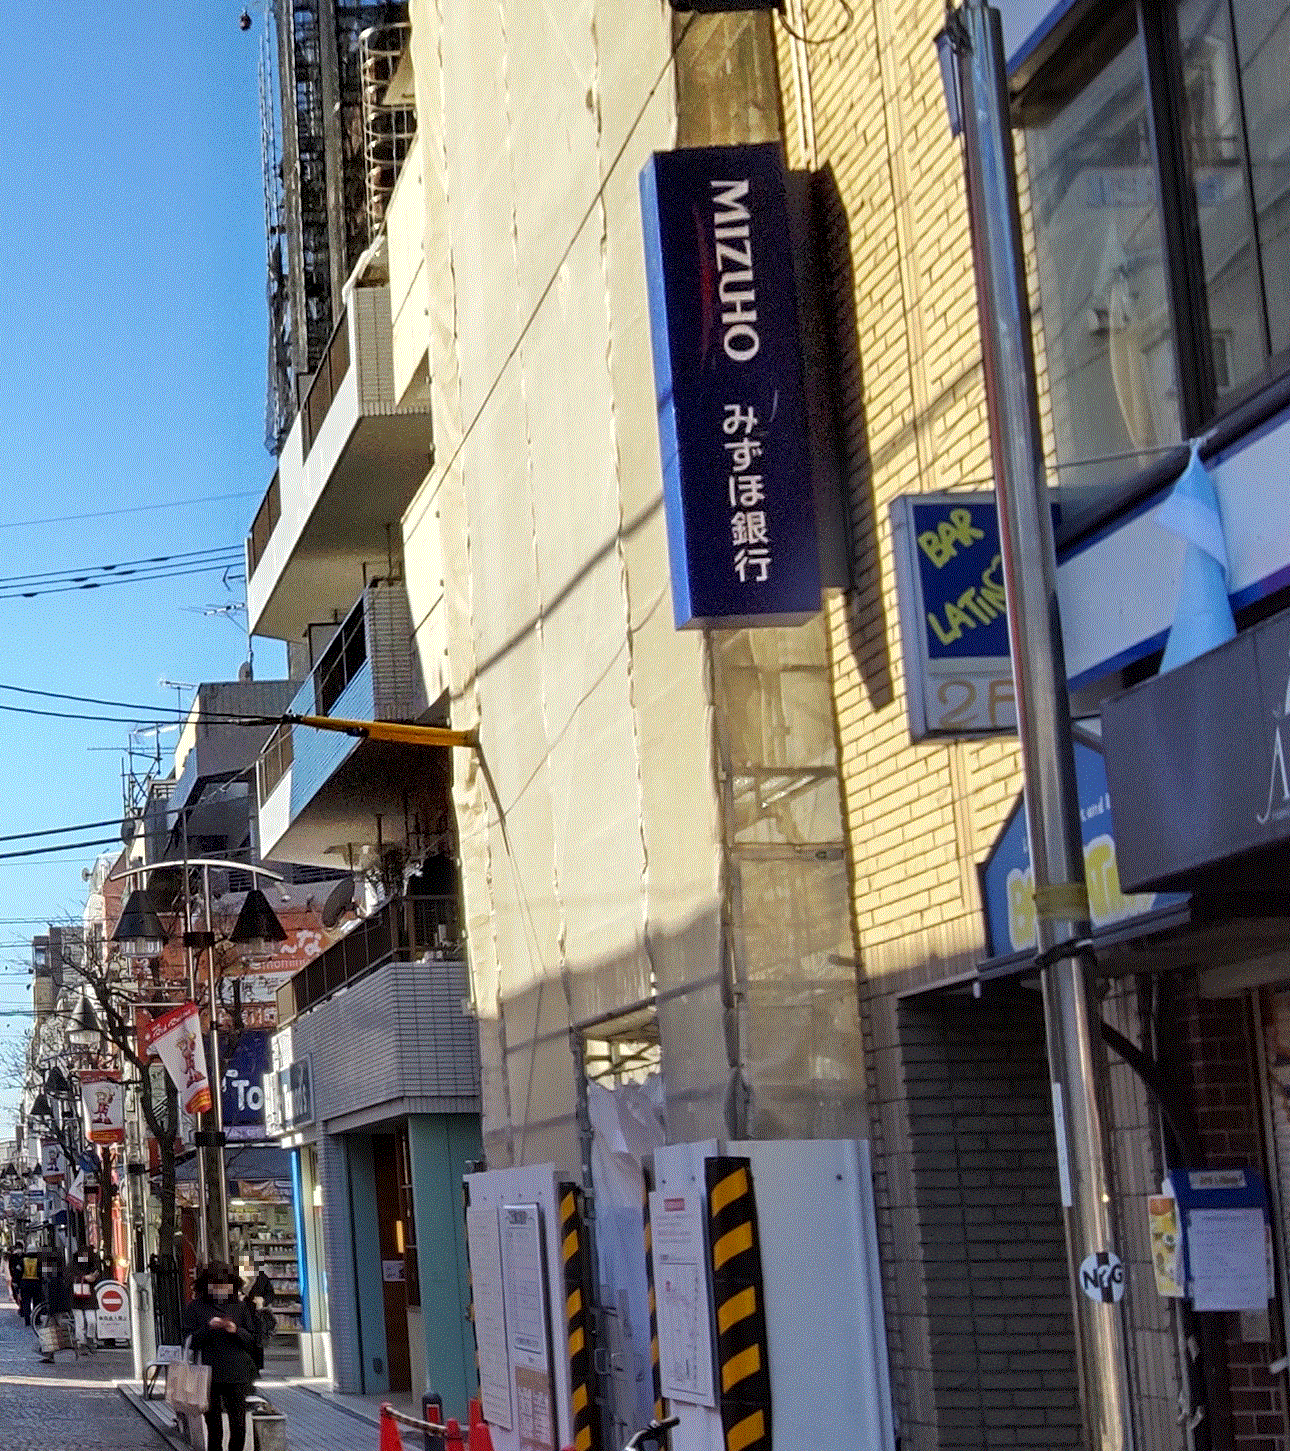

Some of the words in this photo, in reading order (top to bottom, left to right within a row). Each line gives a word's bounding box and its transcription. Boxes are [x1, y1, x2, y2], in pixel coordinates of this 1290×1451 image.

[710, 179, 760, 362] MIZUHO
[723, 403, 772, 582] みずほ銀行
[917, 507, 985, 568] BAR
[936, 678, 1015, 730] 2F
